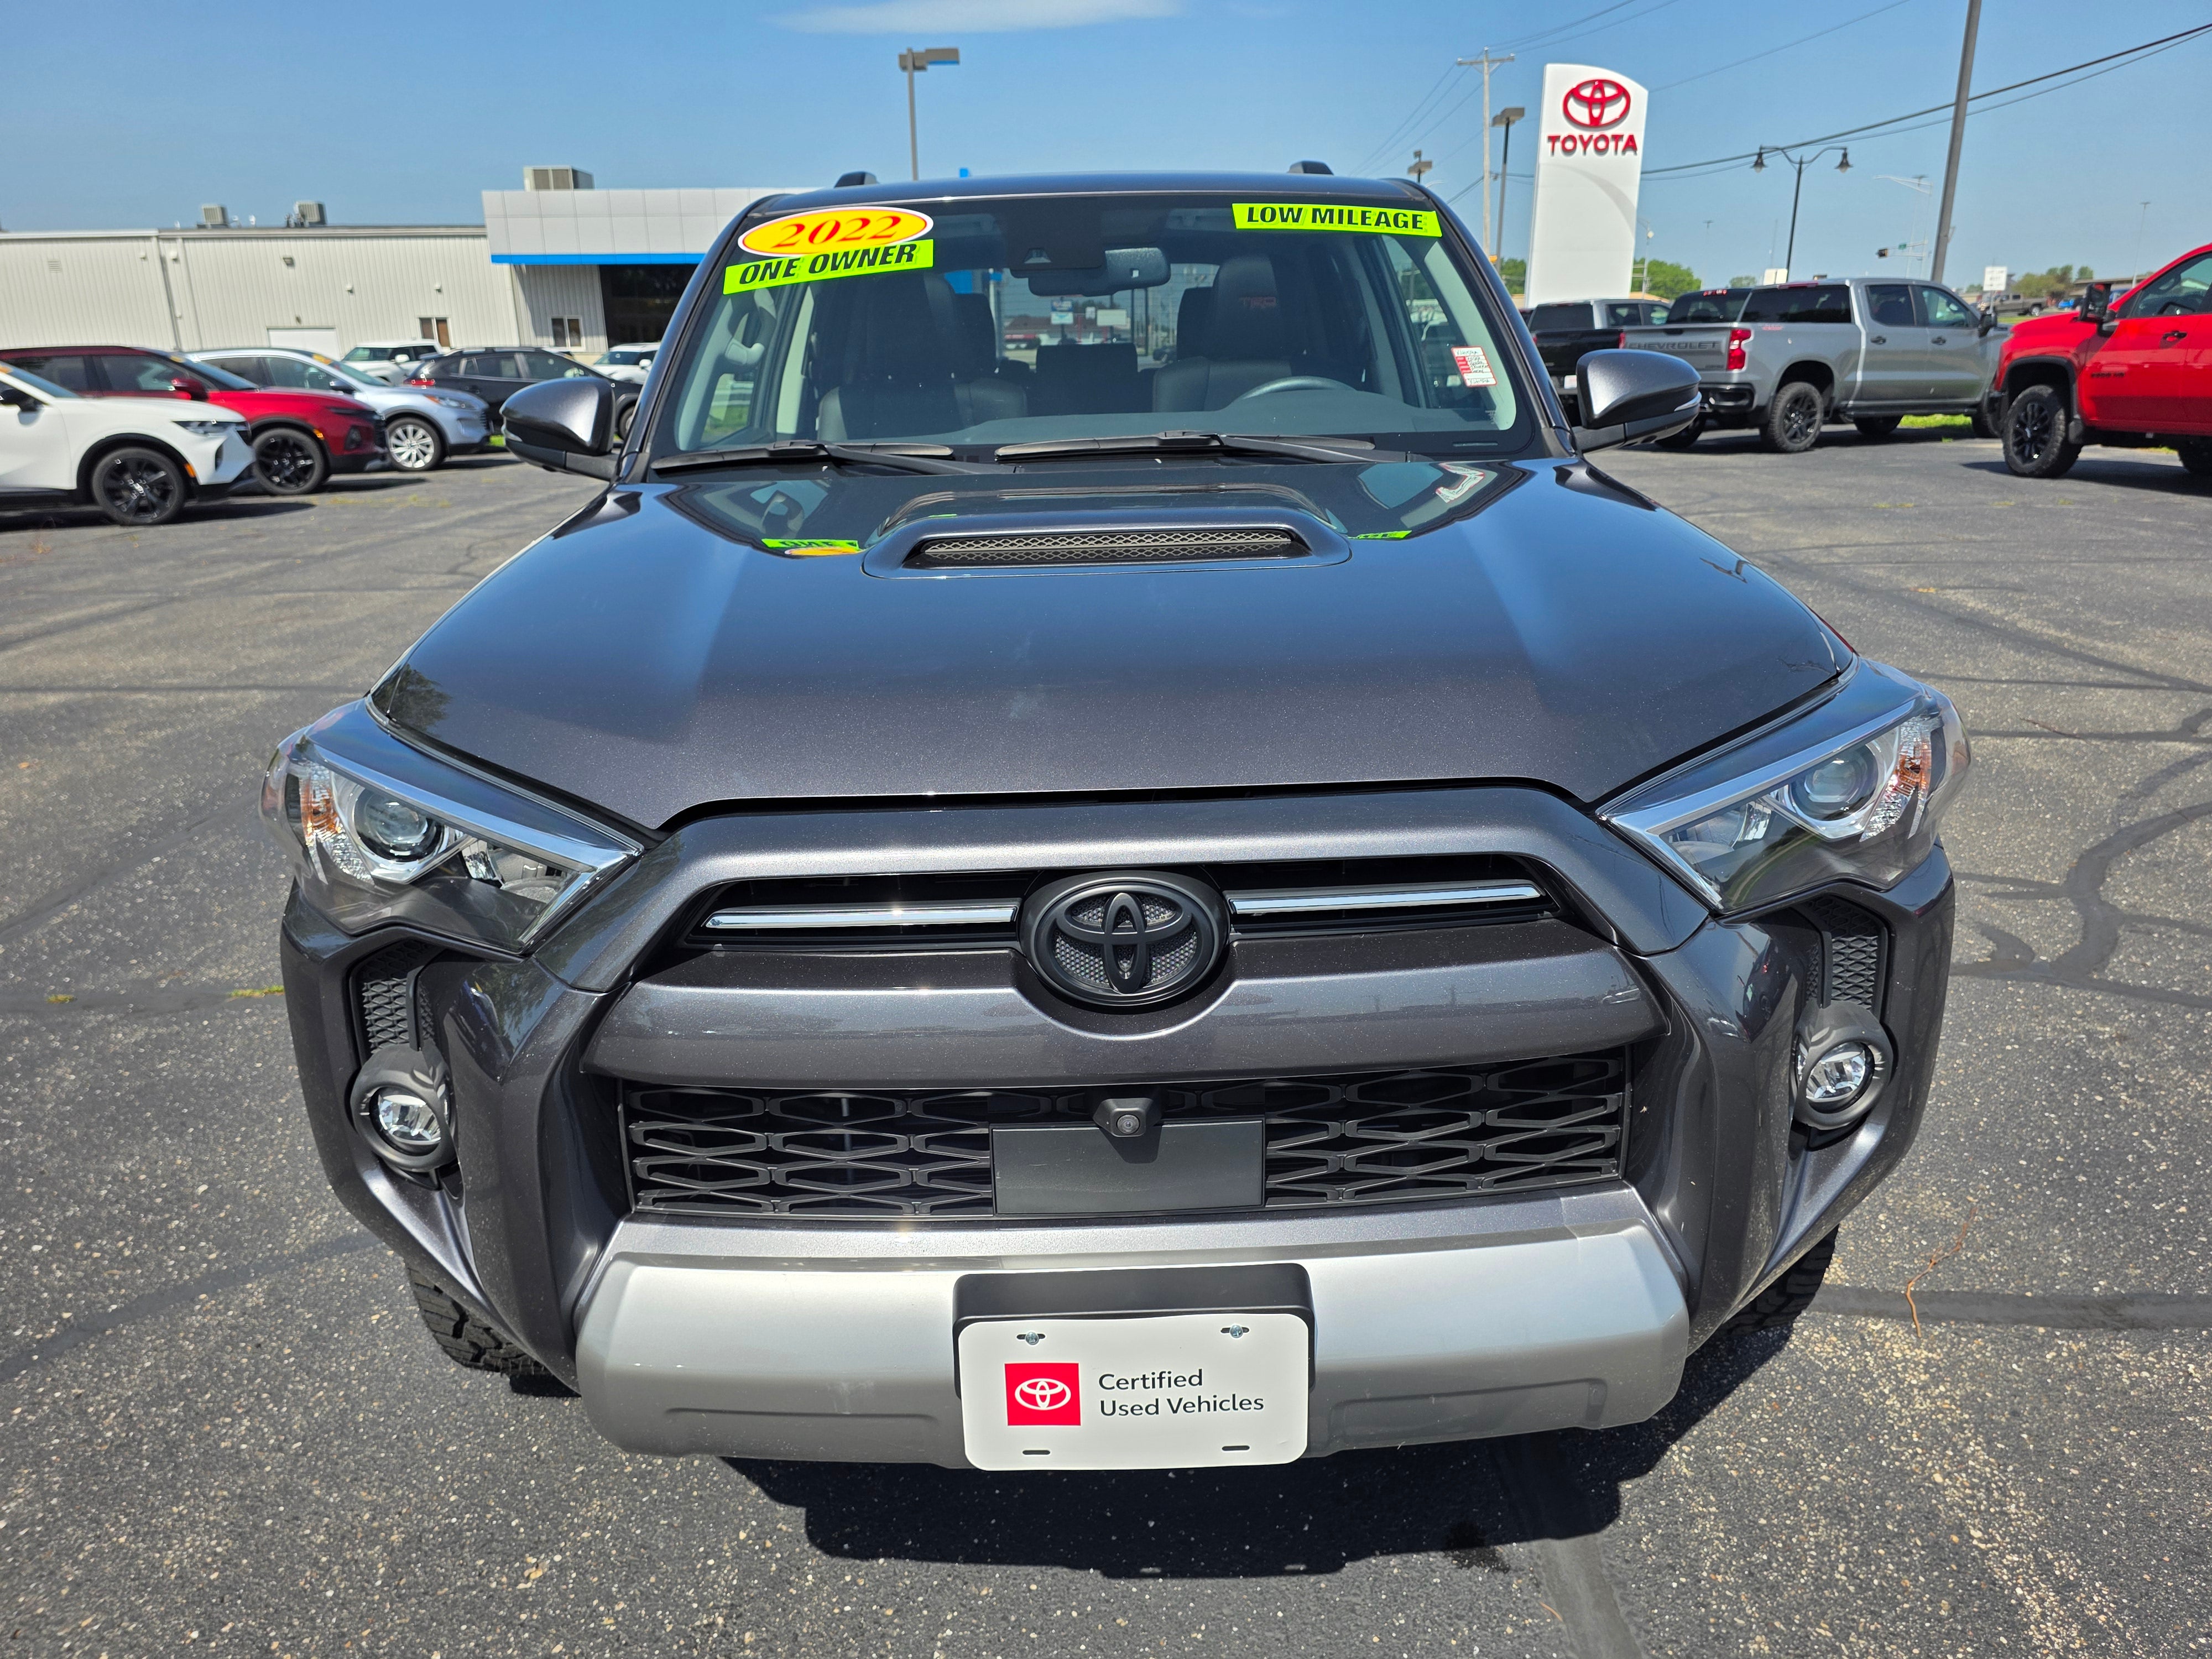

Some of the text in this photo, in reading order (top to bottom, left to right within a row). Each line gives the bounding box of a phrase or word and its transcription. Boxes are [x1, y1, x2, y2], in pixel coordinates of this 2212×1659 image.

[1547, 134, 1637, 154] TOYOTA
[1247, 207, 1423, 229] LOW MILEAGE
[770, 216, 901, 248] 2022
[739, 243, 917, 285] ONE OWNER
[1628, 341, 1721, 350] CHEVROLET
[1099, 1369, 1203, 1390] Certified
[1100, 1394, 1264, 1416] Used Vehicles
